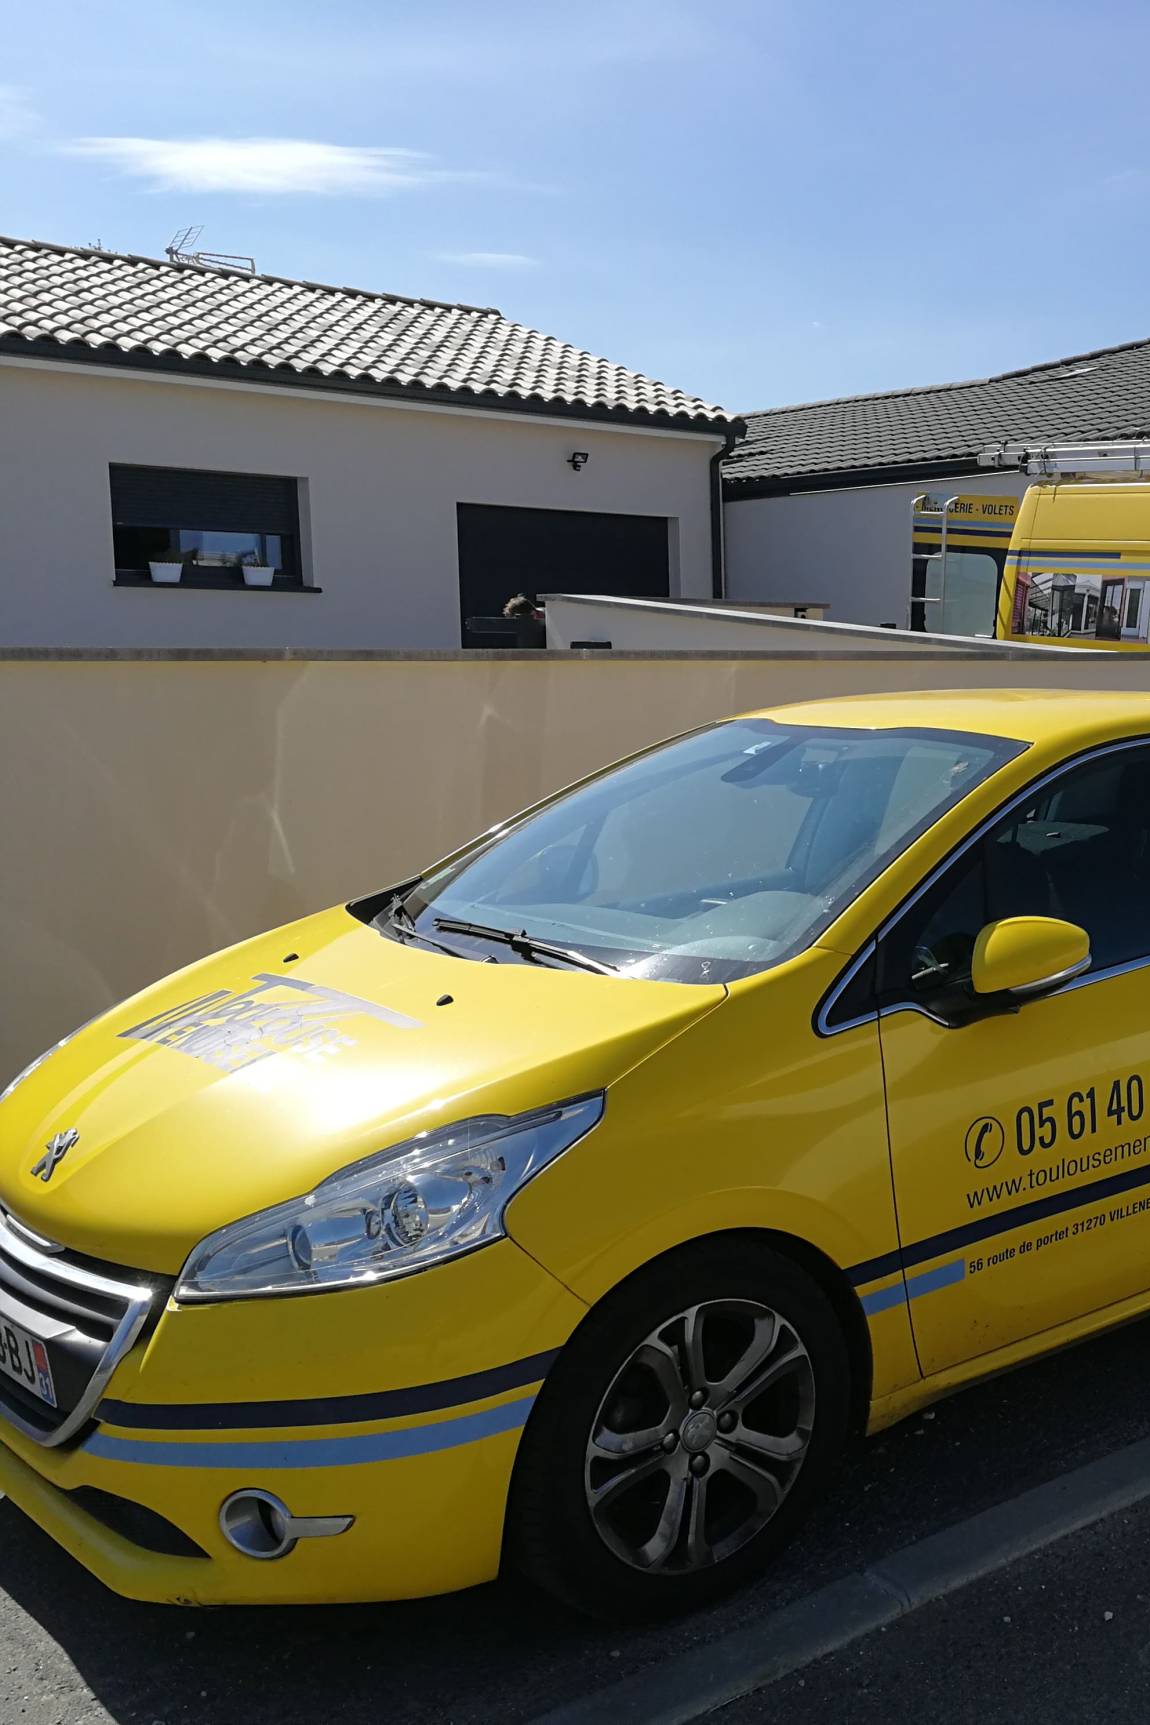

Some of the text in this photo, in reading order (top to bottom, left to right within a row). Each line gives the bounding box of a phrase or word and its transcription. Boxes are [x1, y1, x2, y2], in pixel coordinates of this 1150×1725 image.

[981, 504, 1015, 517] VOLETS
[1016, 1099, 1057, 1156] 05
[1067, 1086, 1097, 1140] 61
[1107, 1074, 1144, 1126] 40
[969, 1258, 984, 1274] 56
[987, 1246, 1016, 1267] route
[1019, 1238, 1033, 1254] de
[1036, 1226, 1069, 1251] portet
[1072, 1213, 1106, 1236] 31270
